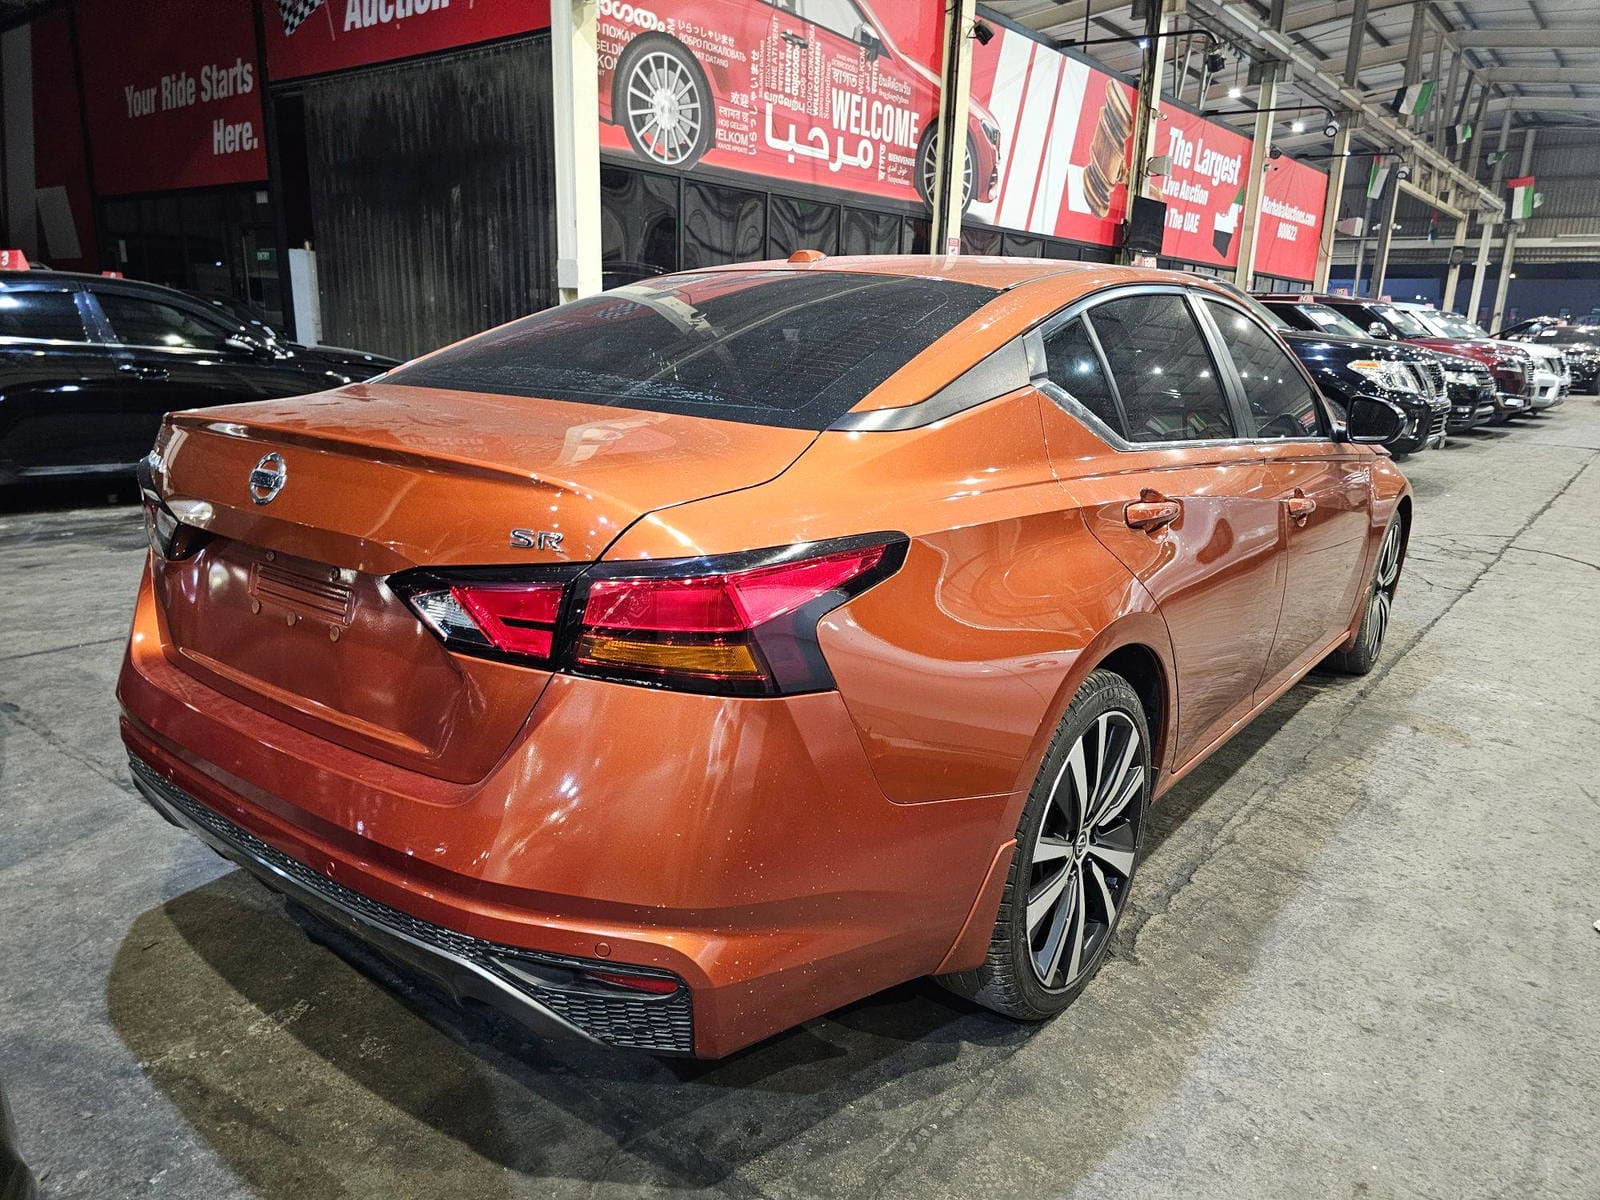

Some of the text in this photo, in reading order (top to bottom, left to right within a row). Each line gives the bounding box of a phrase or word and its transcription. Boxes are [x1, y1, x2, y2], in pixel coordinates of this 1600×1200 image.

[124, 57, 254, 118] Your Ride Starts
[213, 118, 259, 155] Here.
[831, 87, 920, 149] WELCOME
[715, 128, 749, 146] ELKOM
[765, 101, 874, 173] مرحبا
[1169, 127, 1243, 187] The Largest
[1162, 175, 1209, 206] Live Auction
[1168, 208, 1182, 230] The
[1183, 211, 1201, 233] UAE
[509, 528, 565, 553] SR
